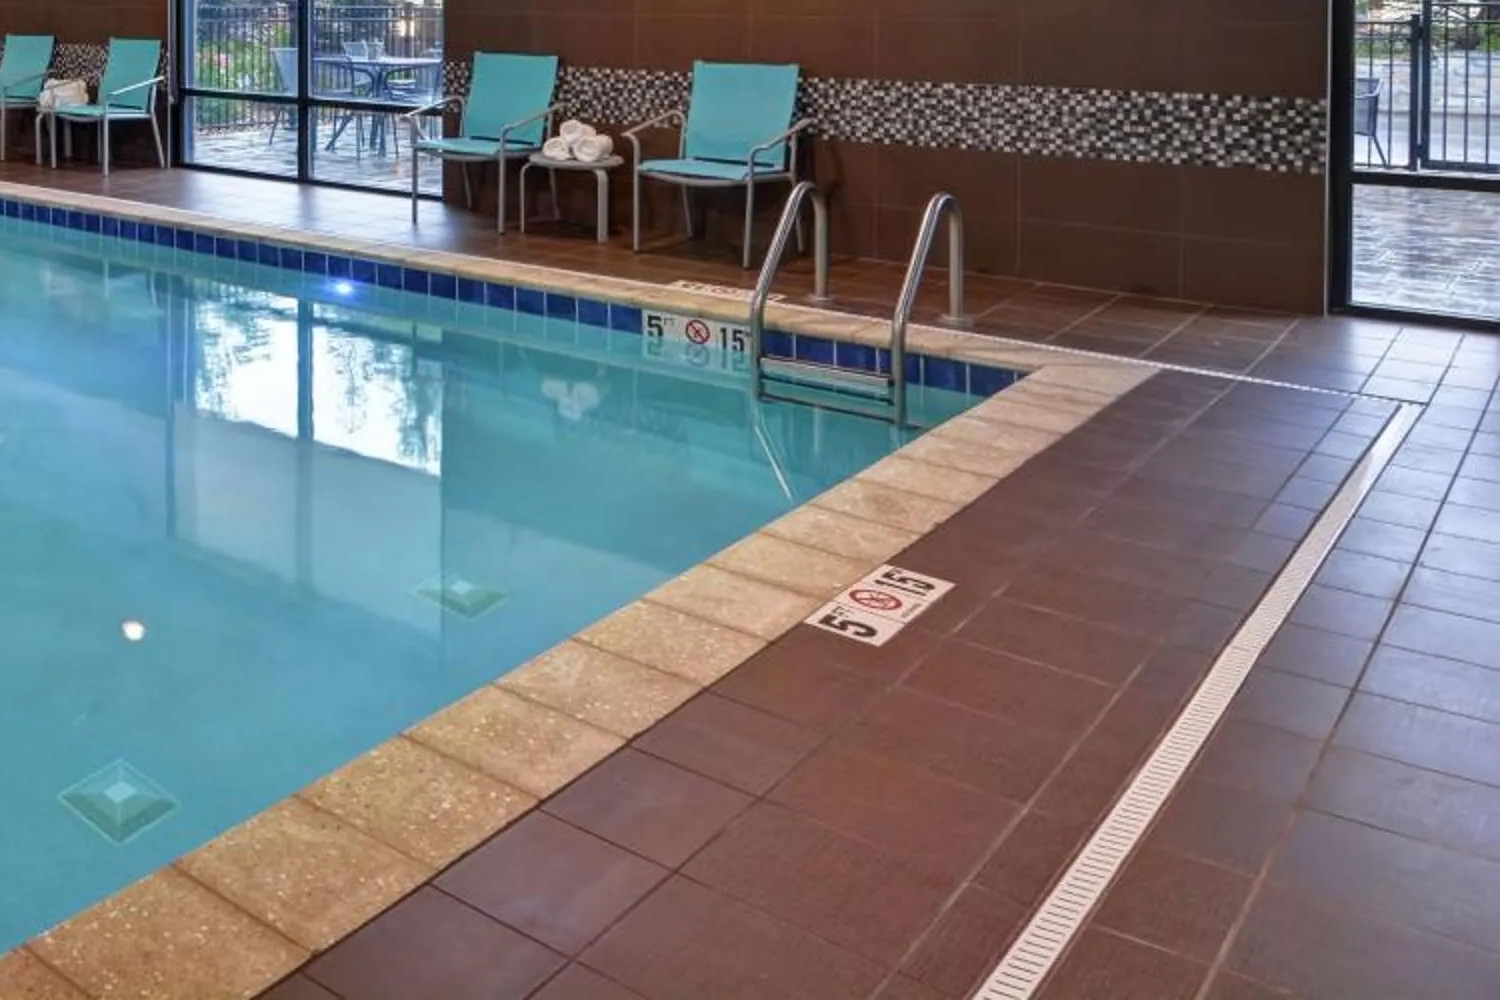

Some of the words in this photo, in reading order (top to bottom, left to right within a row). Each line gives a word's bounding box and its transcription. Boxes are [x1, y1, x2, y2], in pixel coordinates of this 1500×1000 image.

[647, 315, 664, 337] 5
[719, 327, 745, 352] 15
[874, 570, 936, 597] 15
[819, 613, 878, 638] 5
